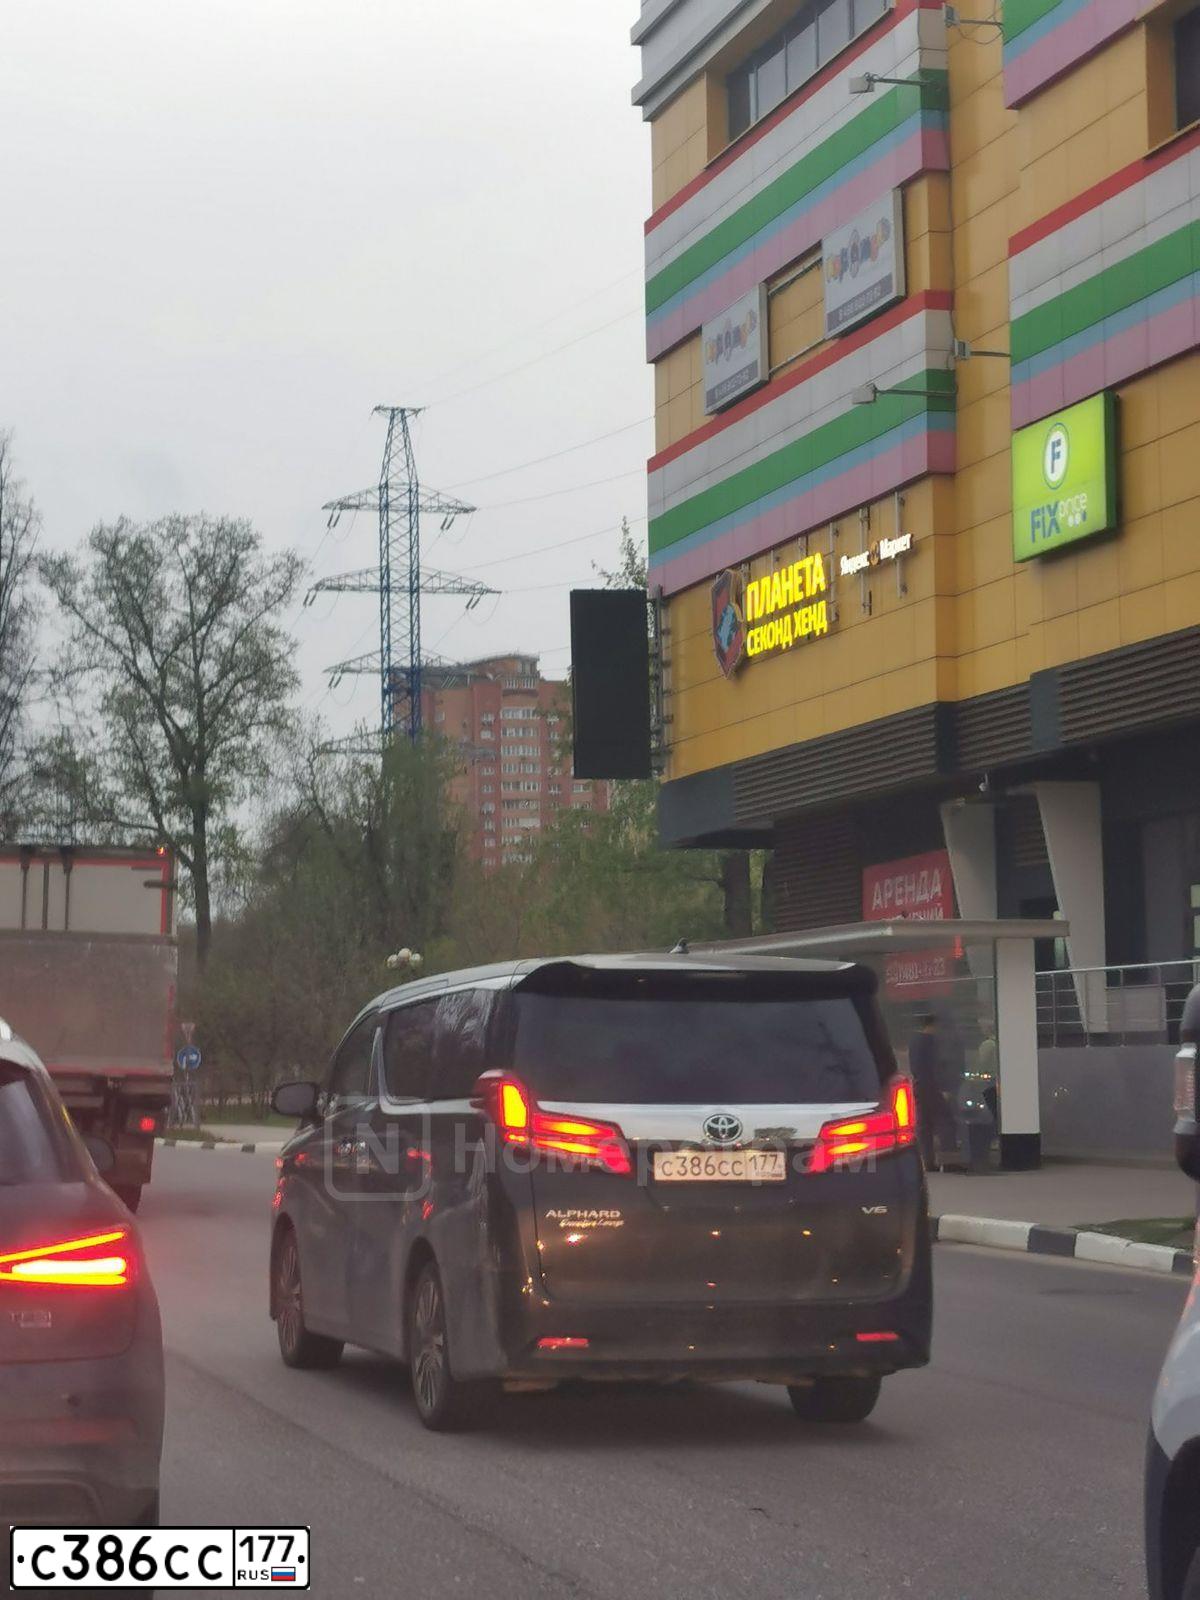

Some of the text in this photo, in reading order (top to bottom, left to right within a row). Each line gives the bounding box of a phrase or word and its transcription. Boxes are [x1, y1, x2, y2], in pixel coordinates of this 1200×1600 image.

[1030, 501, 1060, 543] FIX
[879, 533, 913, 560] Маркет
[747, 552, 826, 622] ПЛАНЕТА
[747, 600, 829, 657] СЕКОНД ХЕНД
[872, 867, 943, 911] АРЕНДА
[661, 1154, 778, 1176] С386СС 177
[545, 1209, 622, 1219] ALPHARD
[861, 1206, 888, 1215] V6
